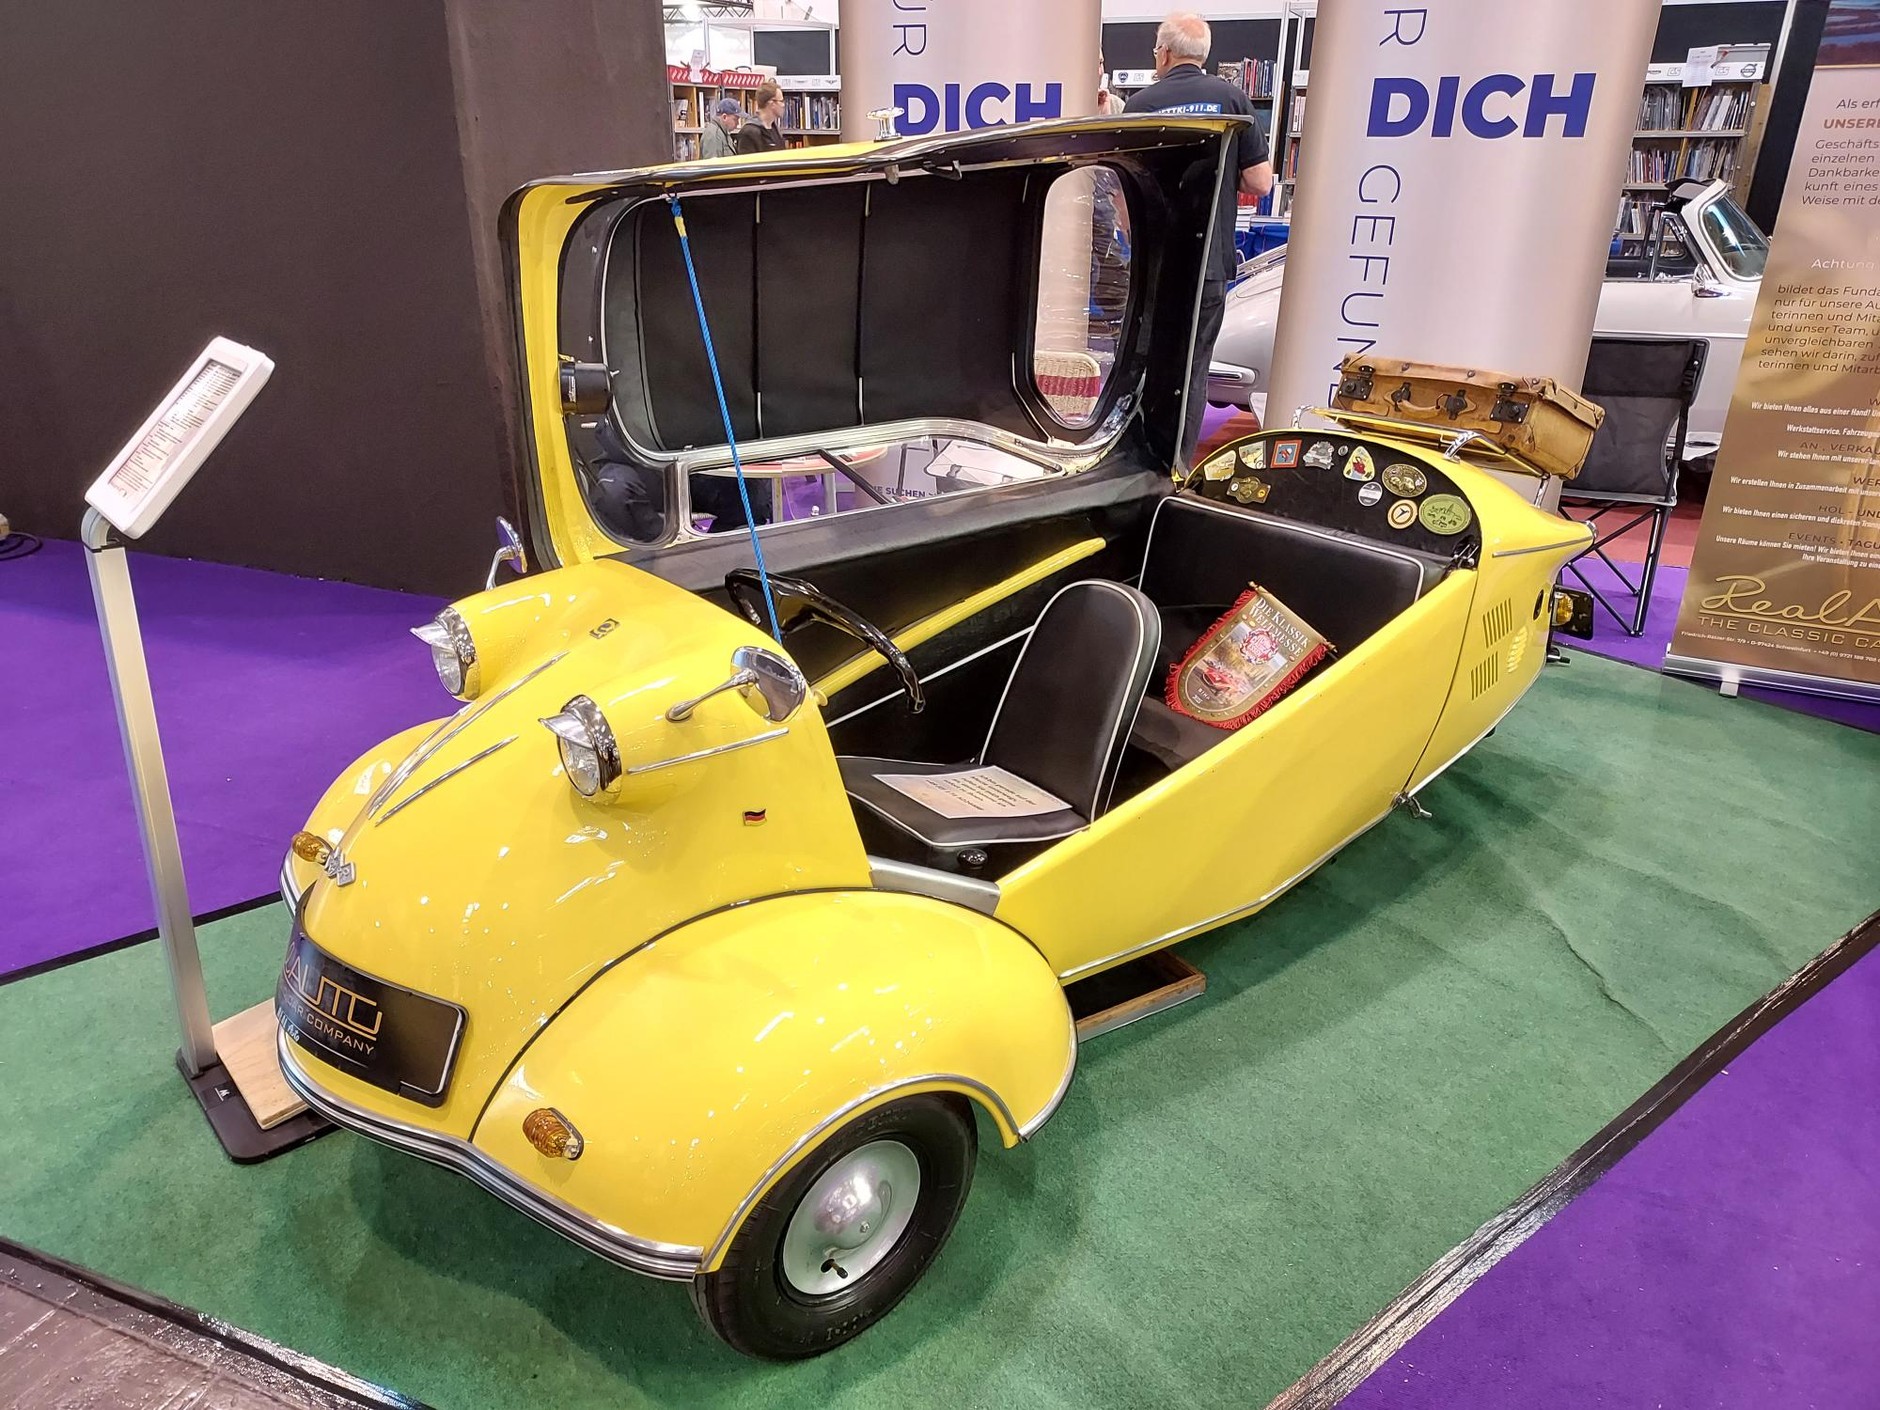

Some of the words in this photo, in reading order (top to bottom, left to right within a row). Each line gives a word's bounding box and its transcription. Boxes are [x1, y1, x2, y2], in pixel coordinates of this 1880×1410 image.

[893, 82, 1062, 136] DICH
[1366, 72, 1597, 139] DICH
[1836, 99, 1858, 109] Als
[1811, 153, 1875, 164] einzelnen
[1804, 181, 1838, 192] kunft
[1843, 182, 1879, 192] eines
[1802, 195, 1839, 205] Weise
[1843, 195, 1865, 205] mit
[1777, 284, 1814, 295] bildet
[1816, 285, 1839, 296] das
[1774, 299, 1796, 307] nur
[1798, 297, 1816, 308] für
[1819, 300, 1862, 309] unsere
[1771, 310, 1824, 321] terinnen
[1827, 312, 1854, 322] und
[1767, 323, 1793, 332] und
[1794, 324, 1829, 334] unser
[1764, 335, 1874, 349] unvergleichbaren
[1760, 347, 1798, 358] sehen
[1801, 349, 1819, 359] wir
[1758, 360, 1810, 371] terinnen
[1813, 362, 1839, 372] und
[1800, 441, 1818, 450] AN
[1818, 505, 1844, 515] HOL
[1788, 532, 1836, 544] EVENTS
[1254, 597, 1274, 617] DIE
[1272, 611, 1309, 648] KLASSIK
[1249, 605, 1304, 656] WELTMESSE
[1698, 616, 1740, 630] THE
[1747, 623, 1845, 645] CLASSIC
[306, 1011, 375, 1055] COMPANY
